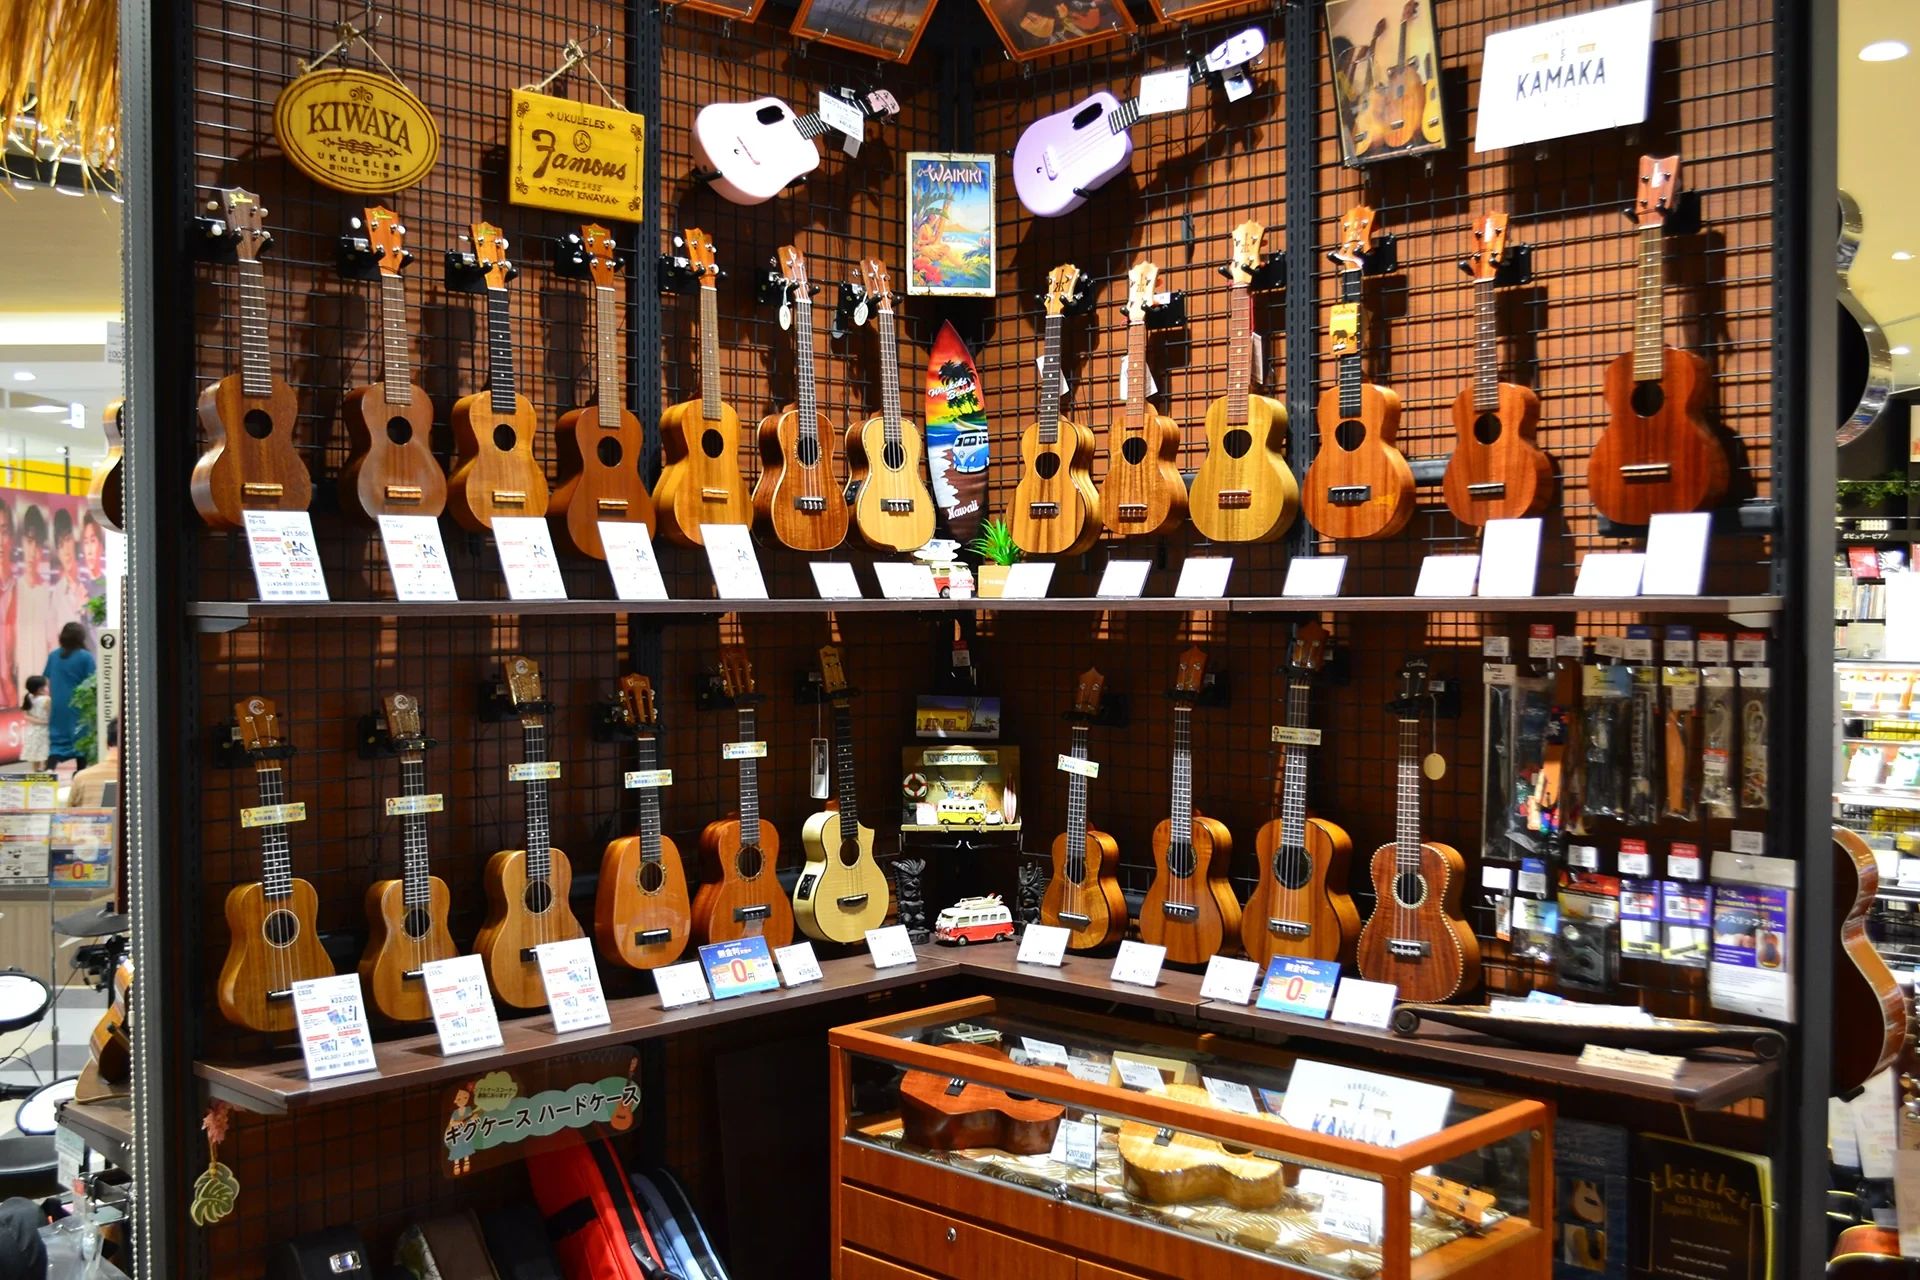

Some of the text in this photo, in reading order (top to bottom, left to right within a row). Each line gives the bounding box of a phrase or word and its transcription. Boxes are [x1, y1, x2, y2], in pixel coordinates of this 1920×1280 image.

[1516, 57, 1606, 101] KAMAKA
[307, 101, 412, 155] KIWAYA
[556, 111, 605, 130] UKULELES
[317, 152, 401, 172] UKULELES
[531, 129, 628, 181] Famous
[329, 164, 361, 175] SINCE
[930, 163, 982, 184] WAIKIKI
[548, 186, 612, 204] FROM KIWAYA
[928, 377, 968, 398] Waikiki
[946, 384, 977, 400] Beach
[947, 499, 980, 520] Hawaii
[446, 1086, 641, 1144] ギグケース ハードケース
